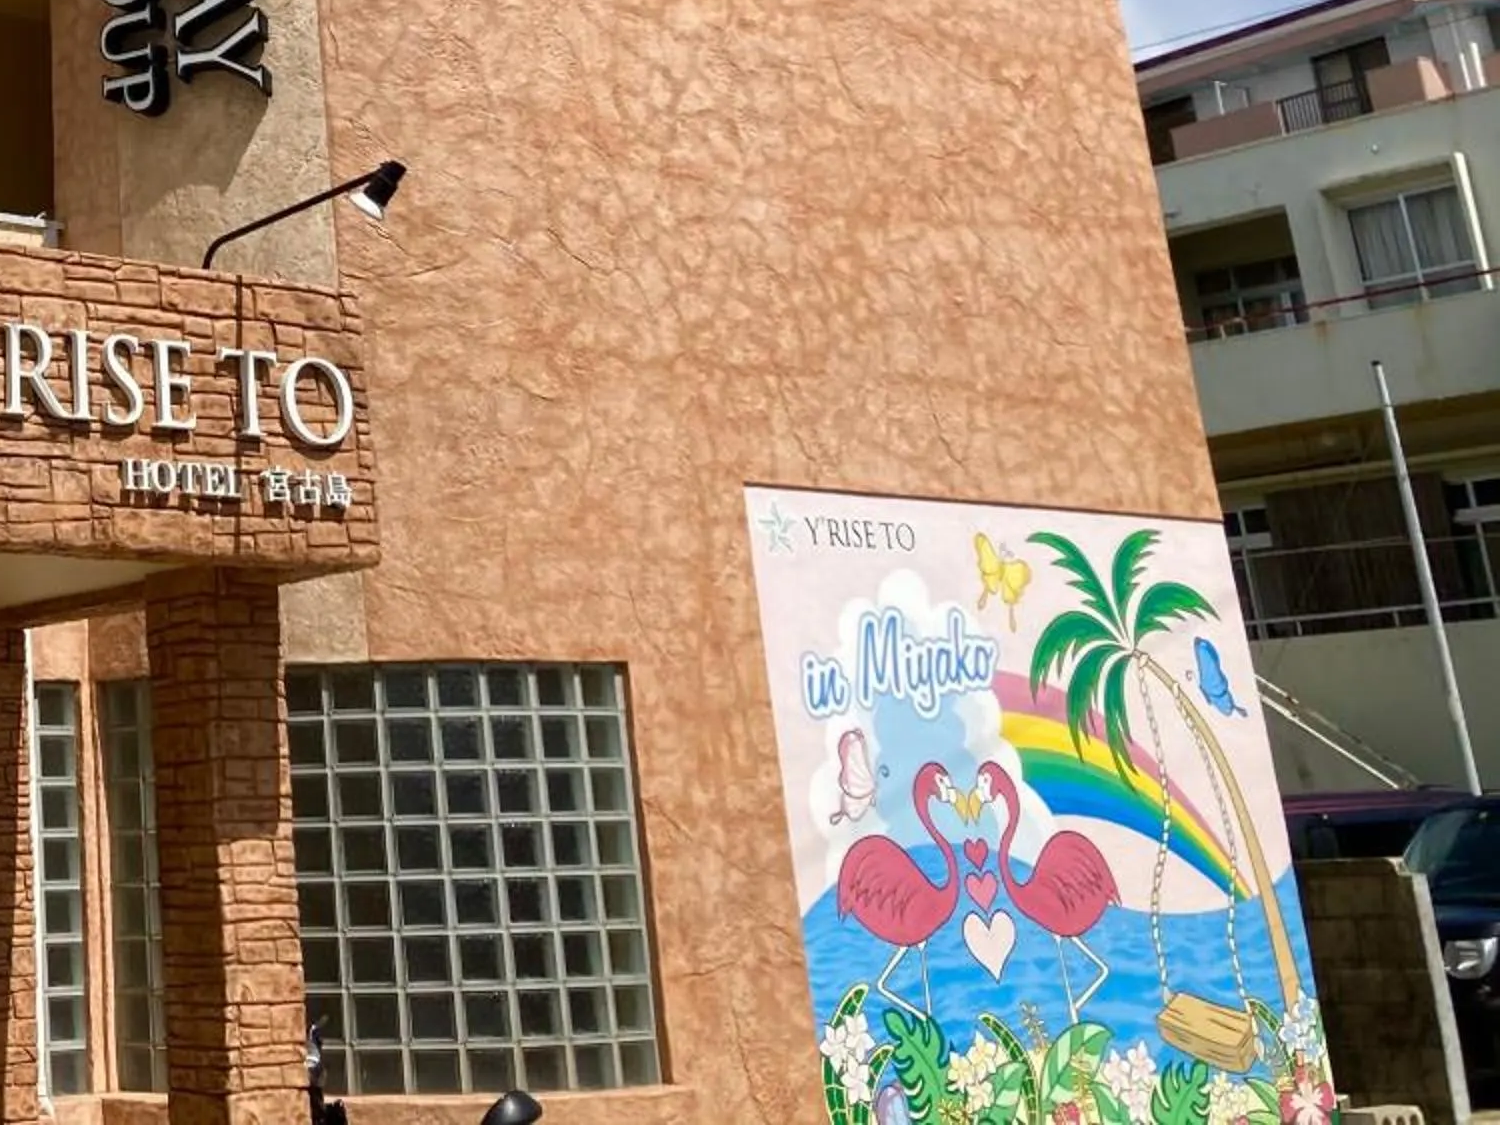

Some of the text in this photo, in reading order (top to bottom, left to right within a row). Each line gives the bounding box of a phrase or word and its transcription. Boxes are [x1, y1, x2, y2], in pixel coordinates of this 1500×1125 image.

[218, 346, 355, 449] TO
[123, 457, 353, 508] HOTEL 宮古島
[880, 522, 916, 552] TO
[804, 612, 995, 715] in Miyako
